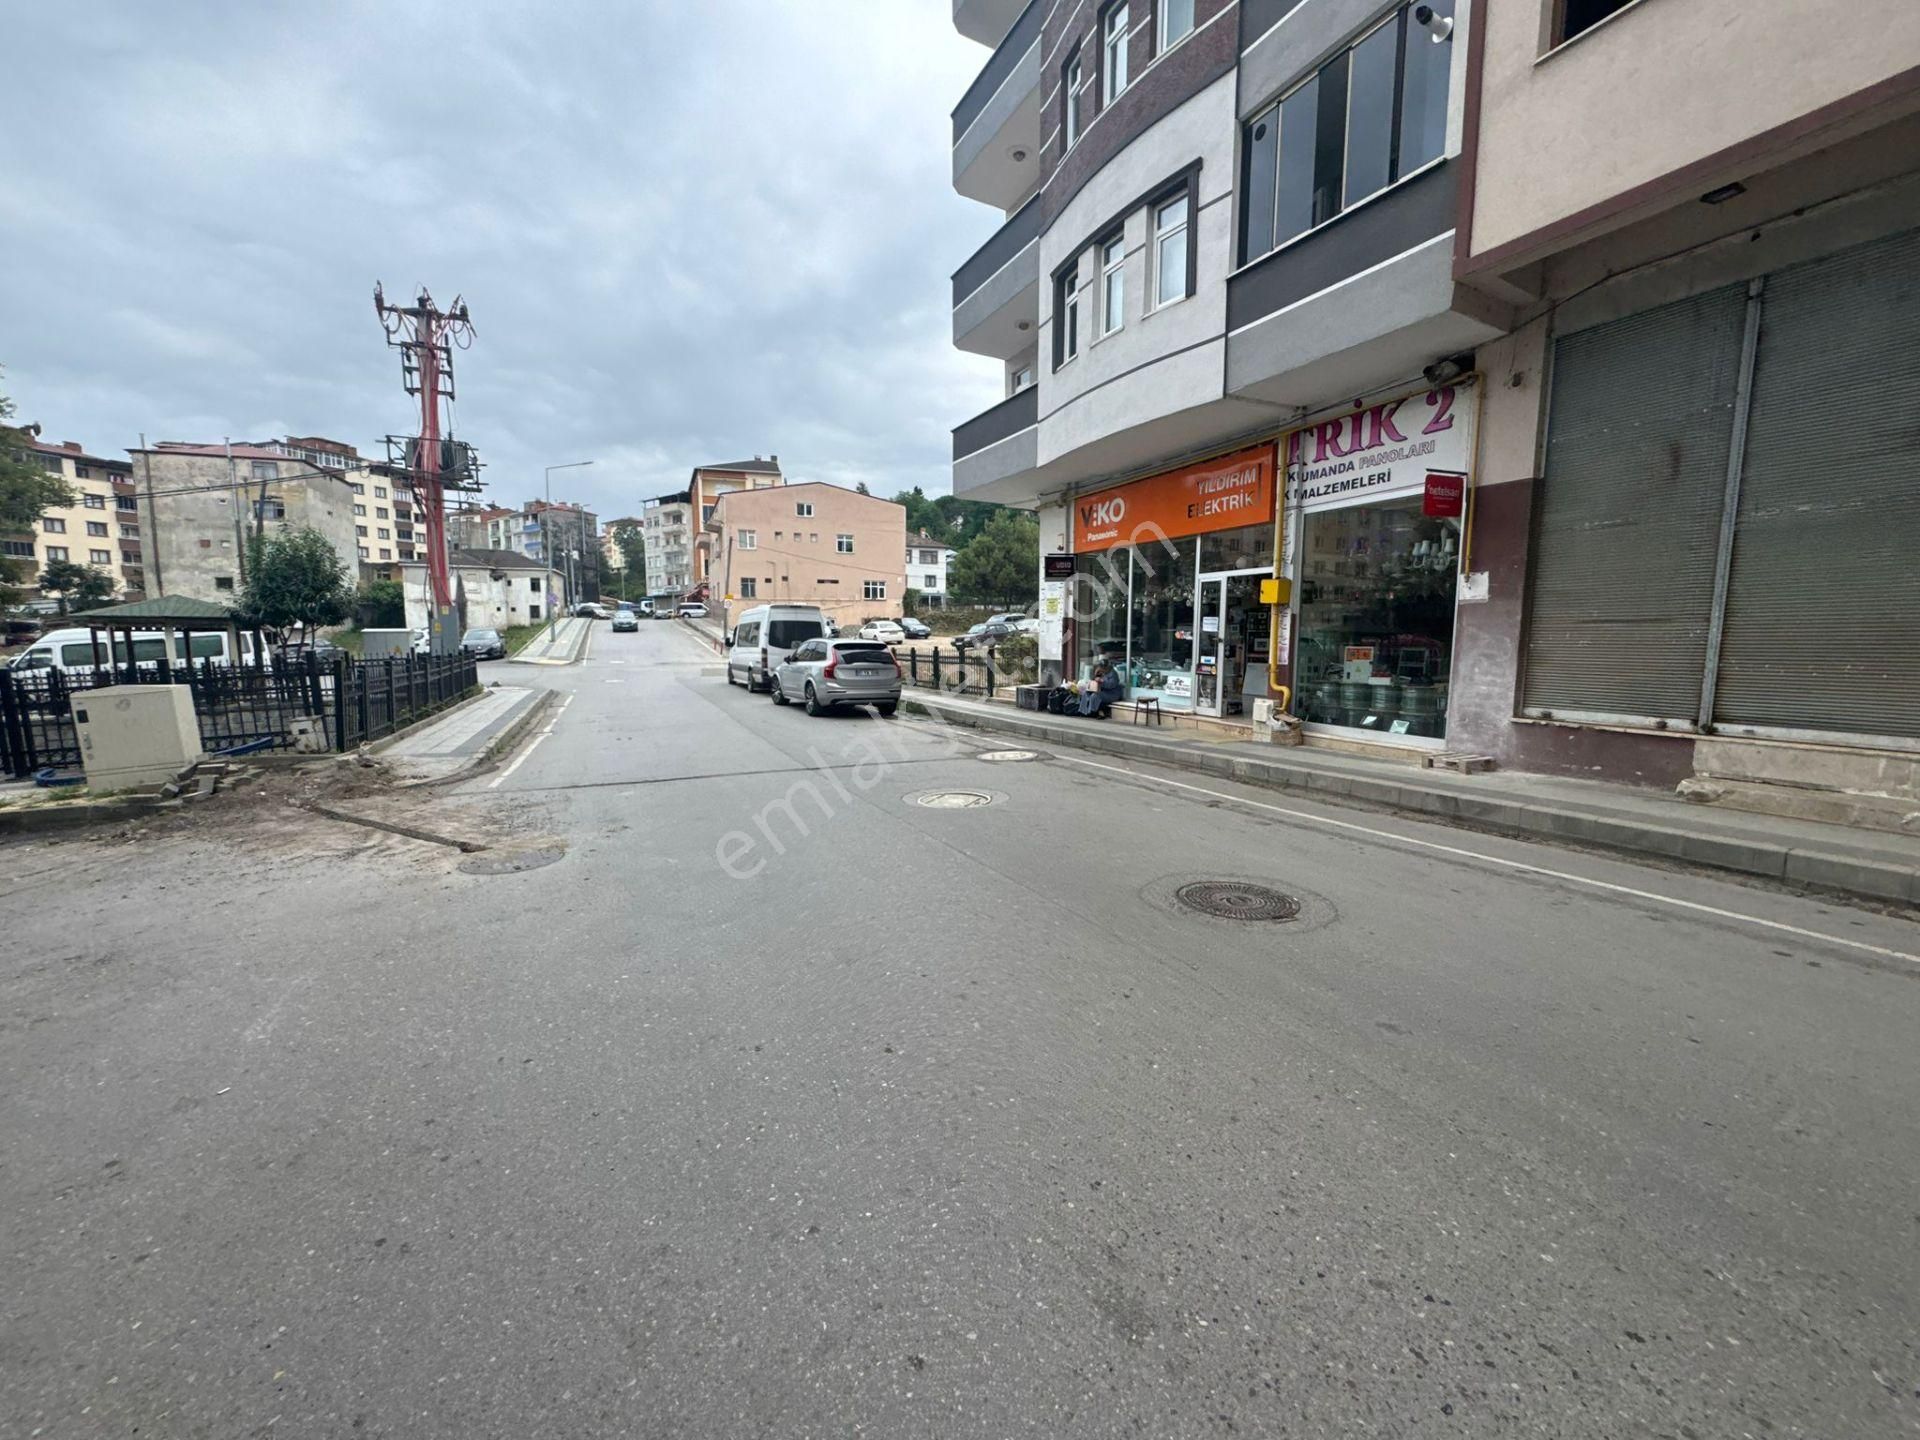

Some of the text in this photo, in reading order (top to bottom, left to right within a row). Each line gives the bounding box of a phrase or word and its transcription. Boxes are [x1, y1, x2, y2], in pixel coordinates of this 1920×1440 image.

[1421, 386, 1456, 435] 2
[1287, 440, 1436, 484] KUMANDA PANOLARI
[1197, 467, 1257, 496] YILDIRIM
[1294, 468, 1392, 500] MALZEMELERİ
[1187, 489, 1255, 519] ELEKTRİK
[1087, 528, 1119, 543] Panasonic
